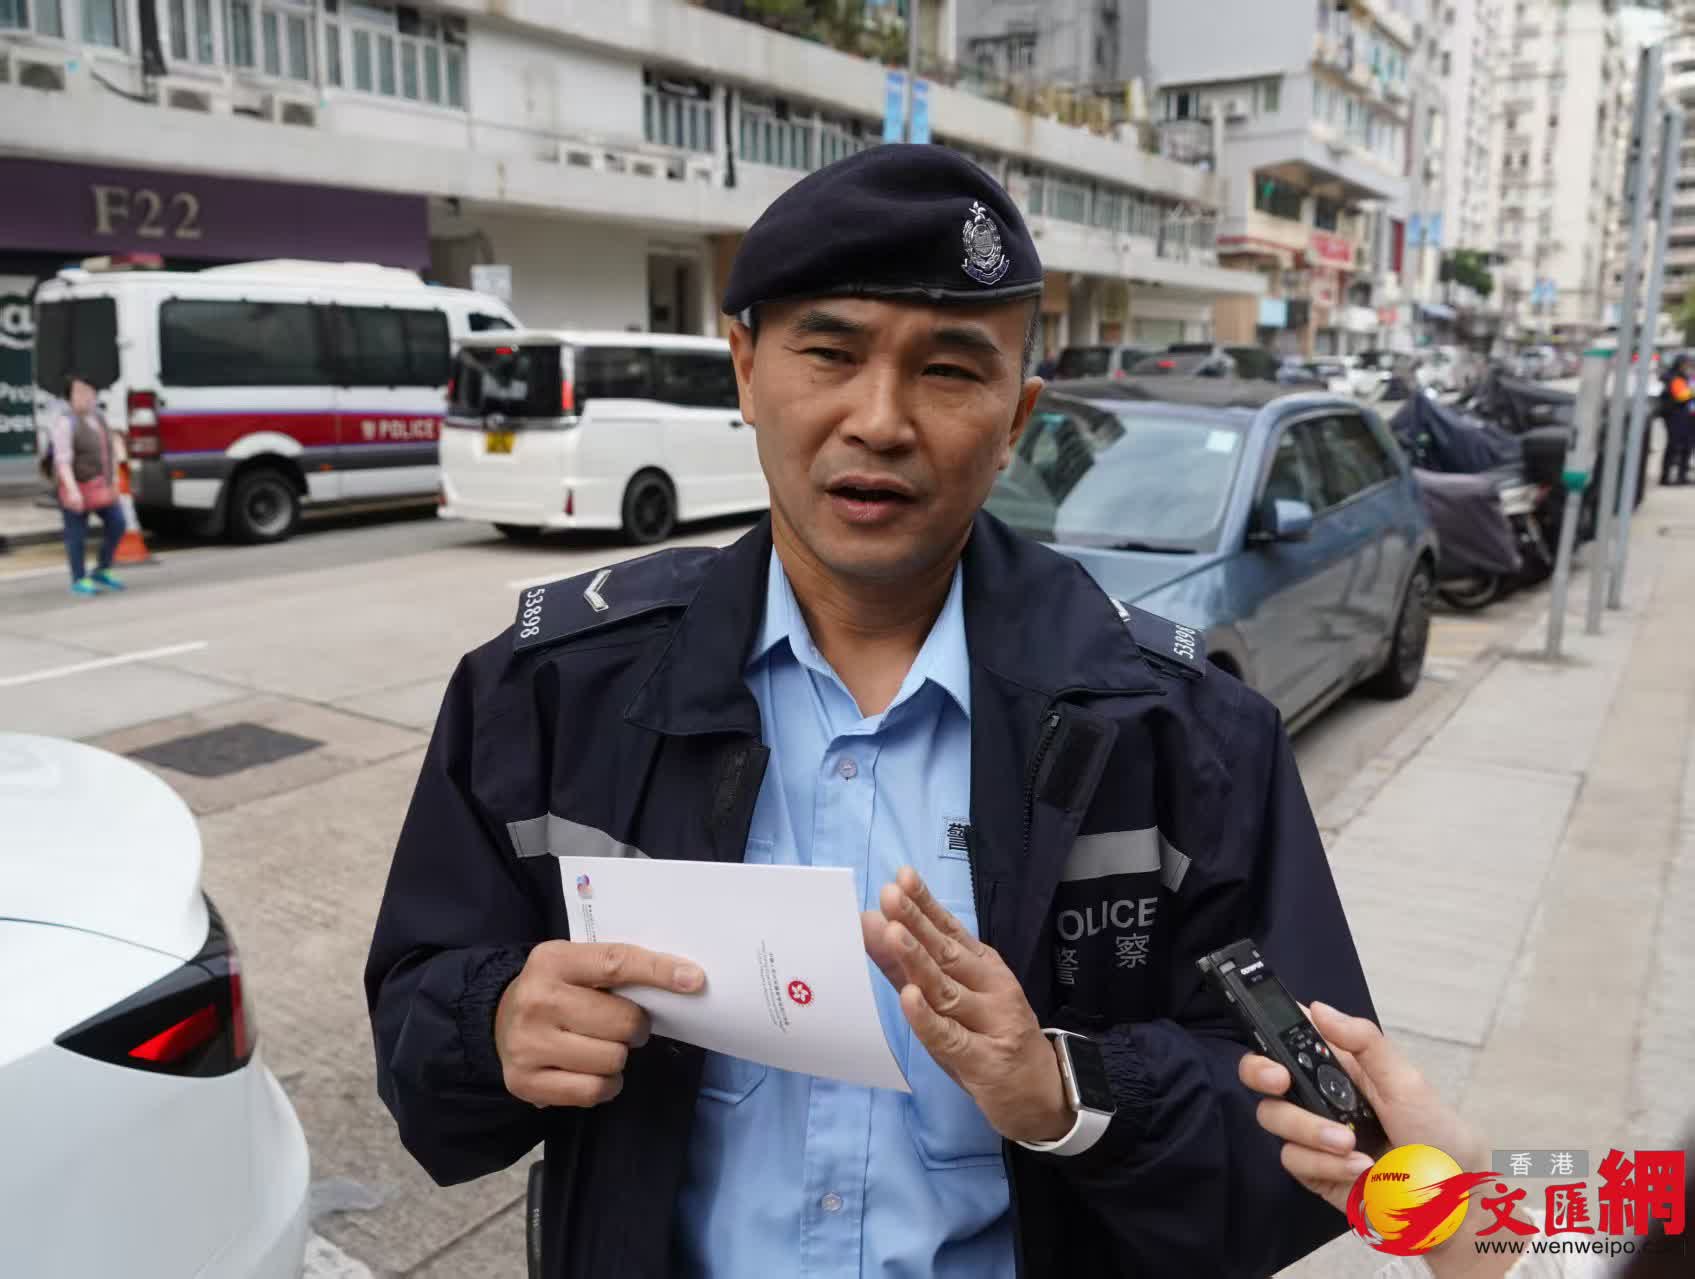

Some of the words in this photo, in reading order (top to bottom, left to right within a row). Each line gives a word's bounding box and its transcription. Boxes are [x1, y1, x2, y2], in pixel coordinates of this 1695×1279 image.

[93, 184, 202, 239] F22
[378, 419, 434, 439] POLICE
[520, 588, 545, 638] 53898
[1057, 897, 1158, 941] OLICE
